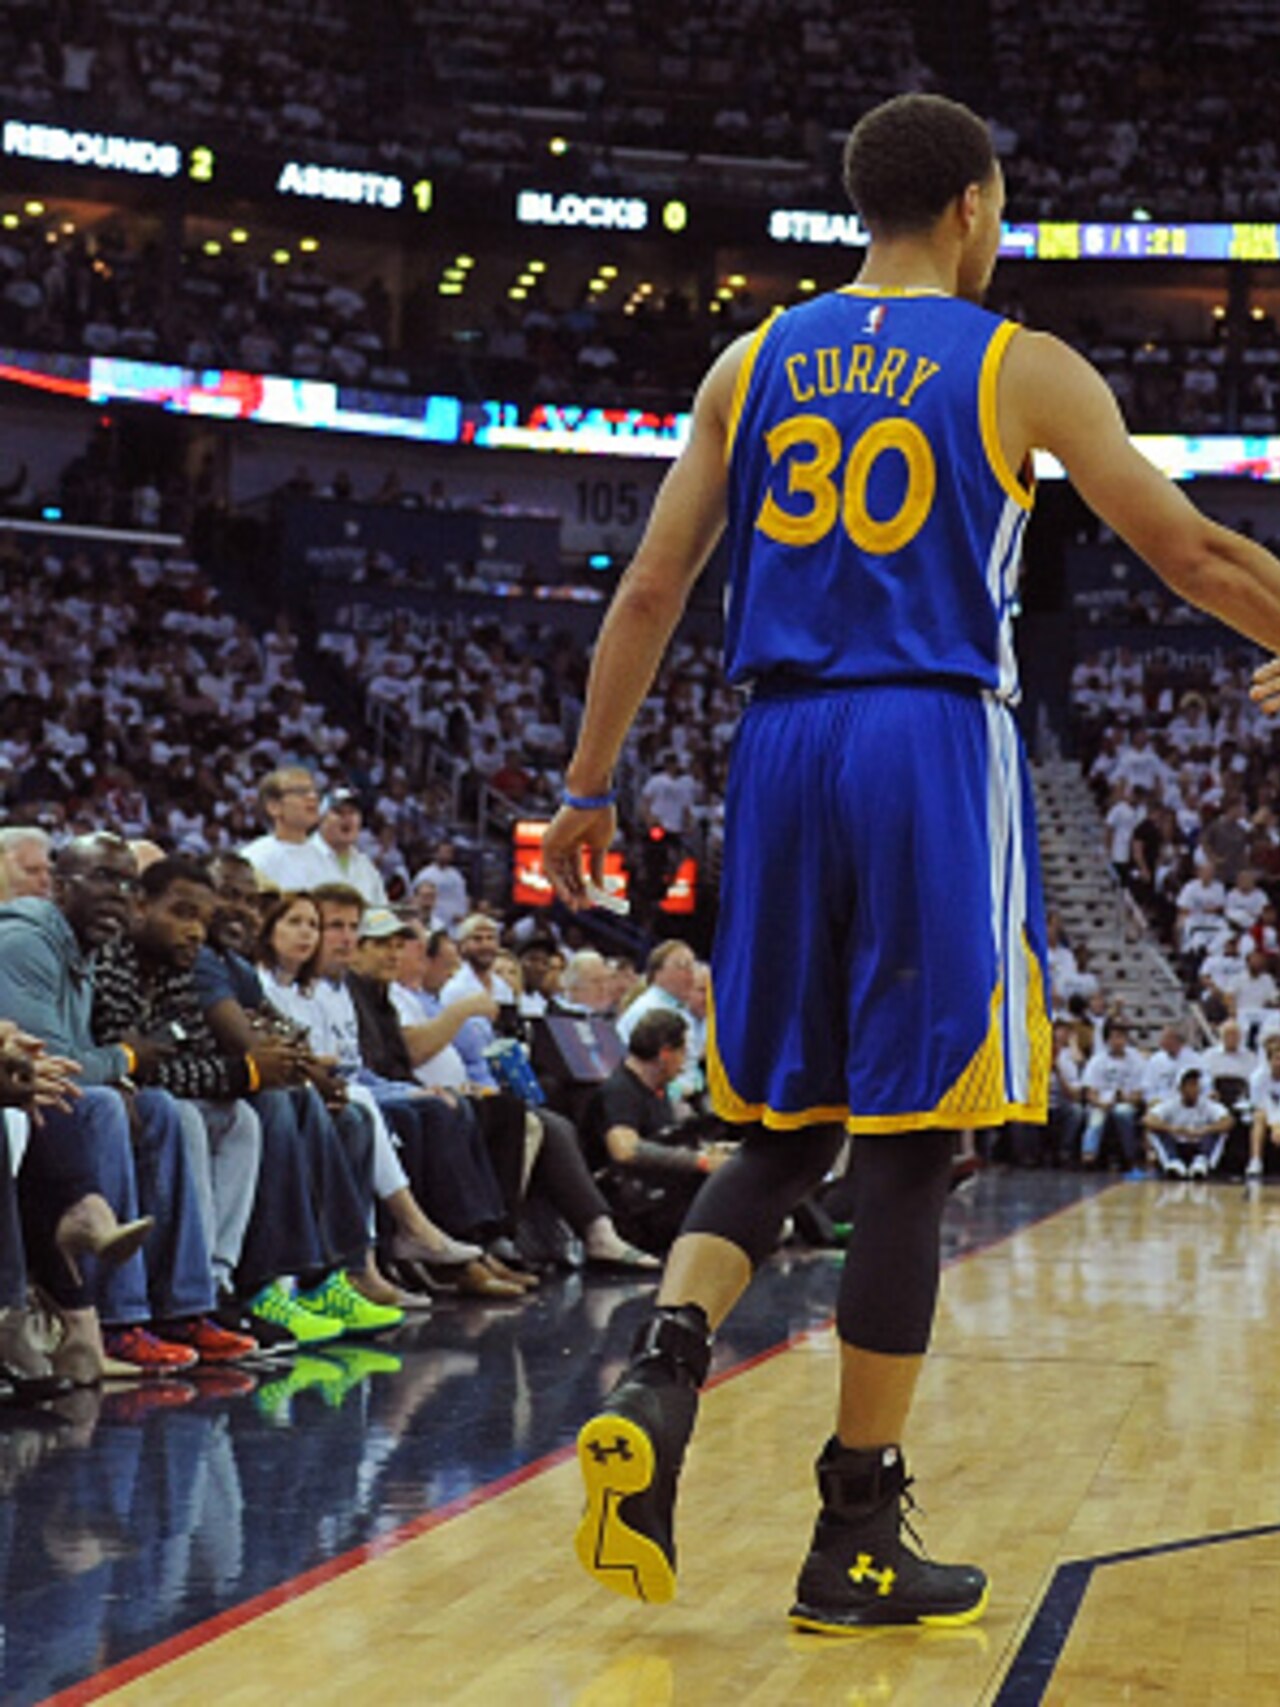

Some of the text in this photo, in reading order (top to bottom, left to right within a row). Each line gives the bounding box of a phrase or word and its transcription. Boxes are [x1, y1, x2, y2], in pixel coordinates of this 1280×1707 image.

[2, 120, 214, 182] REBOUNDS 2
[277, 162, 432, 212] ASSISTS 1
[516, 190, 687, 232] BLOCKS 0
[785, 343, 940, 407] CURRY
[576, 481, 639, 527] 105
[754, 413, 937, 556] 30
